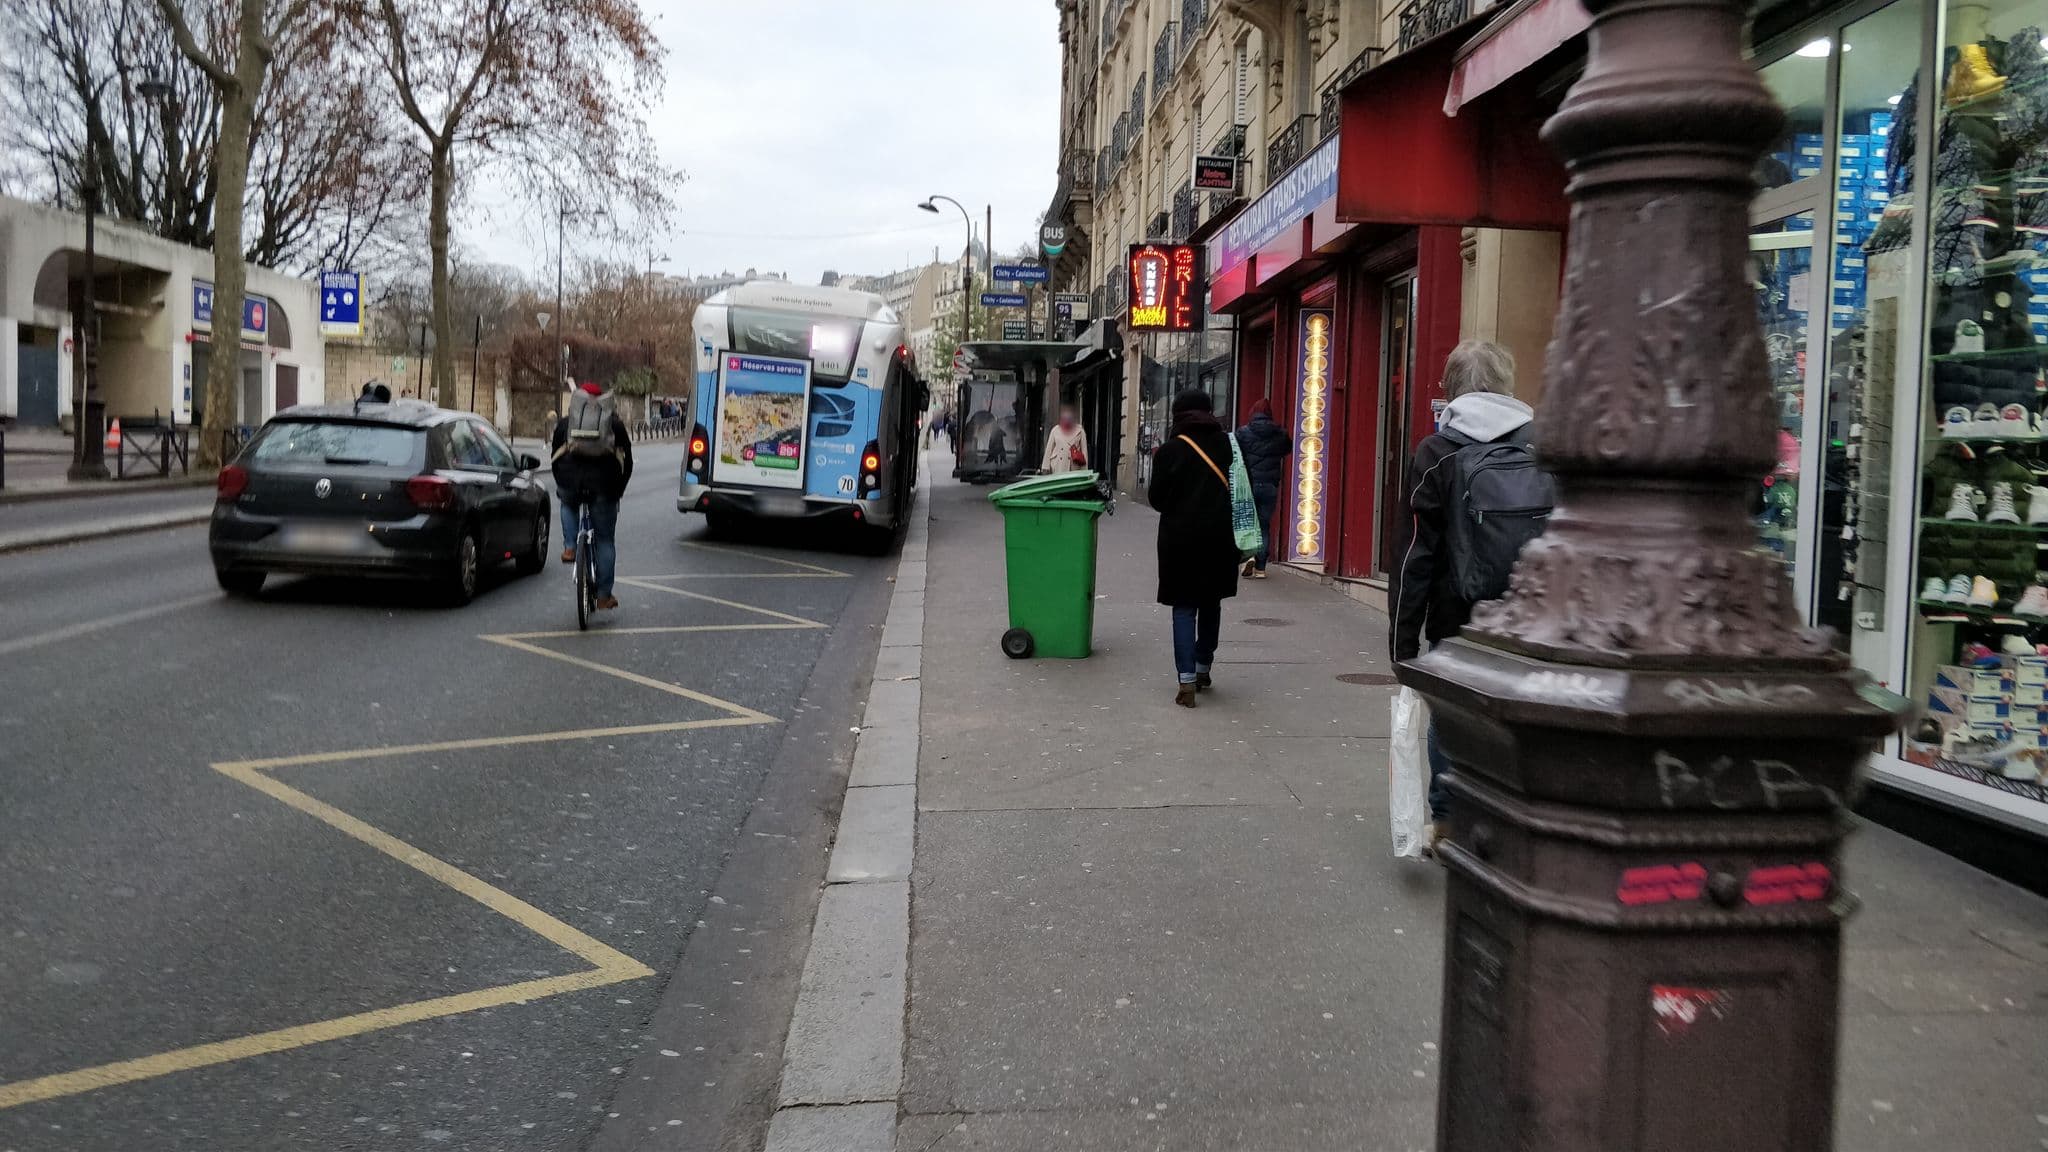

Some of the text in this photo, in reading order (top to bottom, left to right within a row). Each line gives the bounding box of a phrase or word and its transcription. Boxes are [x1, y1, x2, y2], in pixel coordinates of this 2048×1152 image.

[1198, 159, 1233, 168] RESTAURANT
[1228, 134, 1340, 253] RESTAURANT PARIS ISTANBU
[1043, 226, 1065, 240] BUS
[995, 269, 1011, 278] Clichy
[1174, 248, 1193, 328] GRILL
[983, 296, 996, 304] Clichy
[1058, 304, 1070, 314] 95
[841, 478, 855, 491] 70
